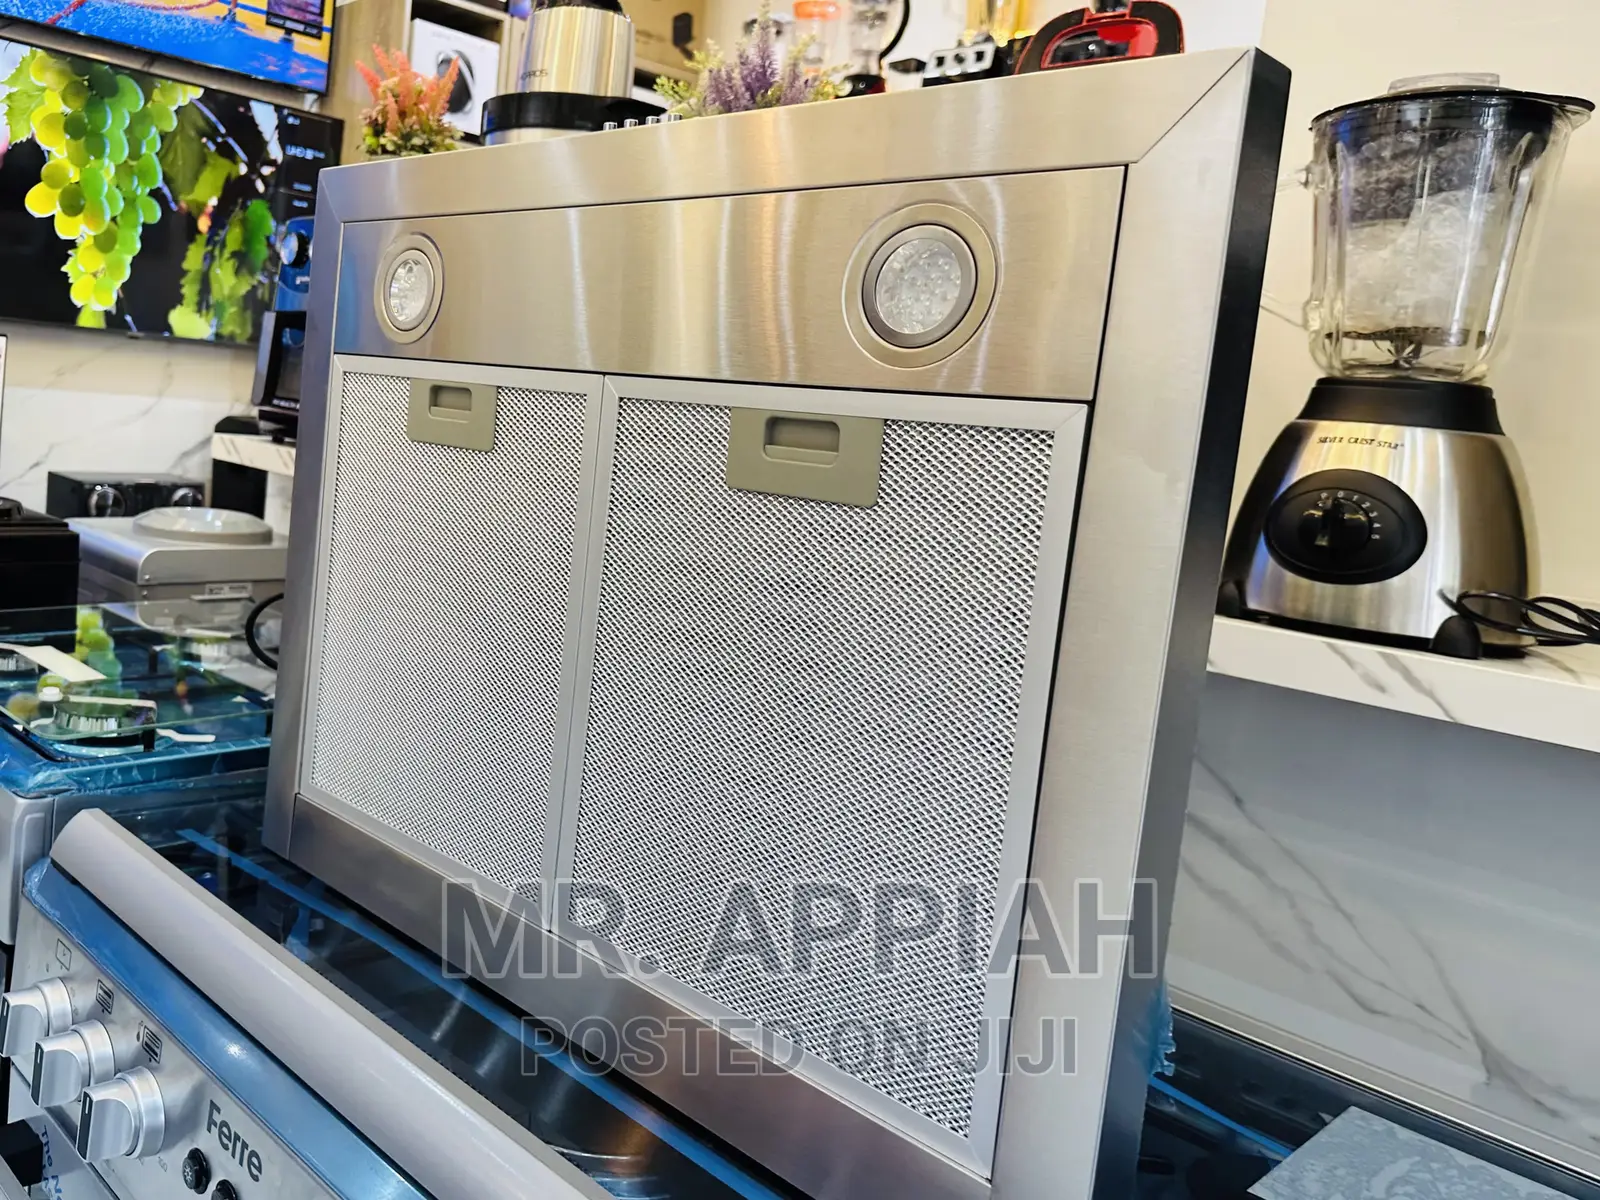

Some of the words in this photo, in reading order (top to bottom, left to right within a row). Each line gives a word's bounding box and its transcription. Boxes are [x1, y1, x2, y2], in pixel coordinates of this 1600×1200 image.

[1347, 436, 1376, 446] CREST
[1361, 501, 1371, 509] 2
[206, 1099, 263, 1183] Ferre
